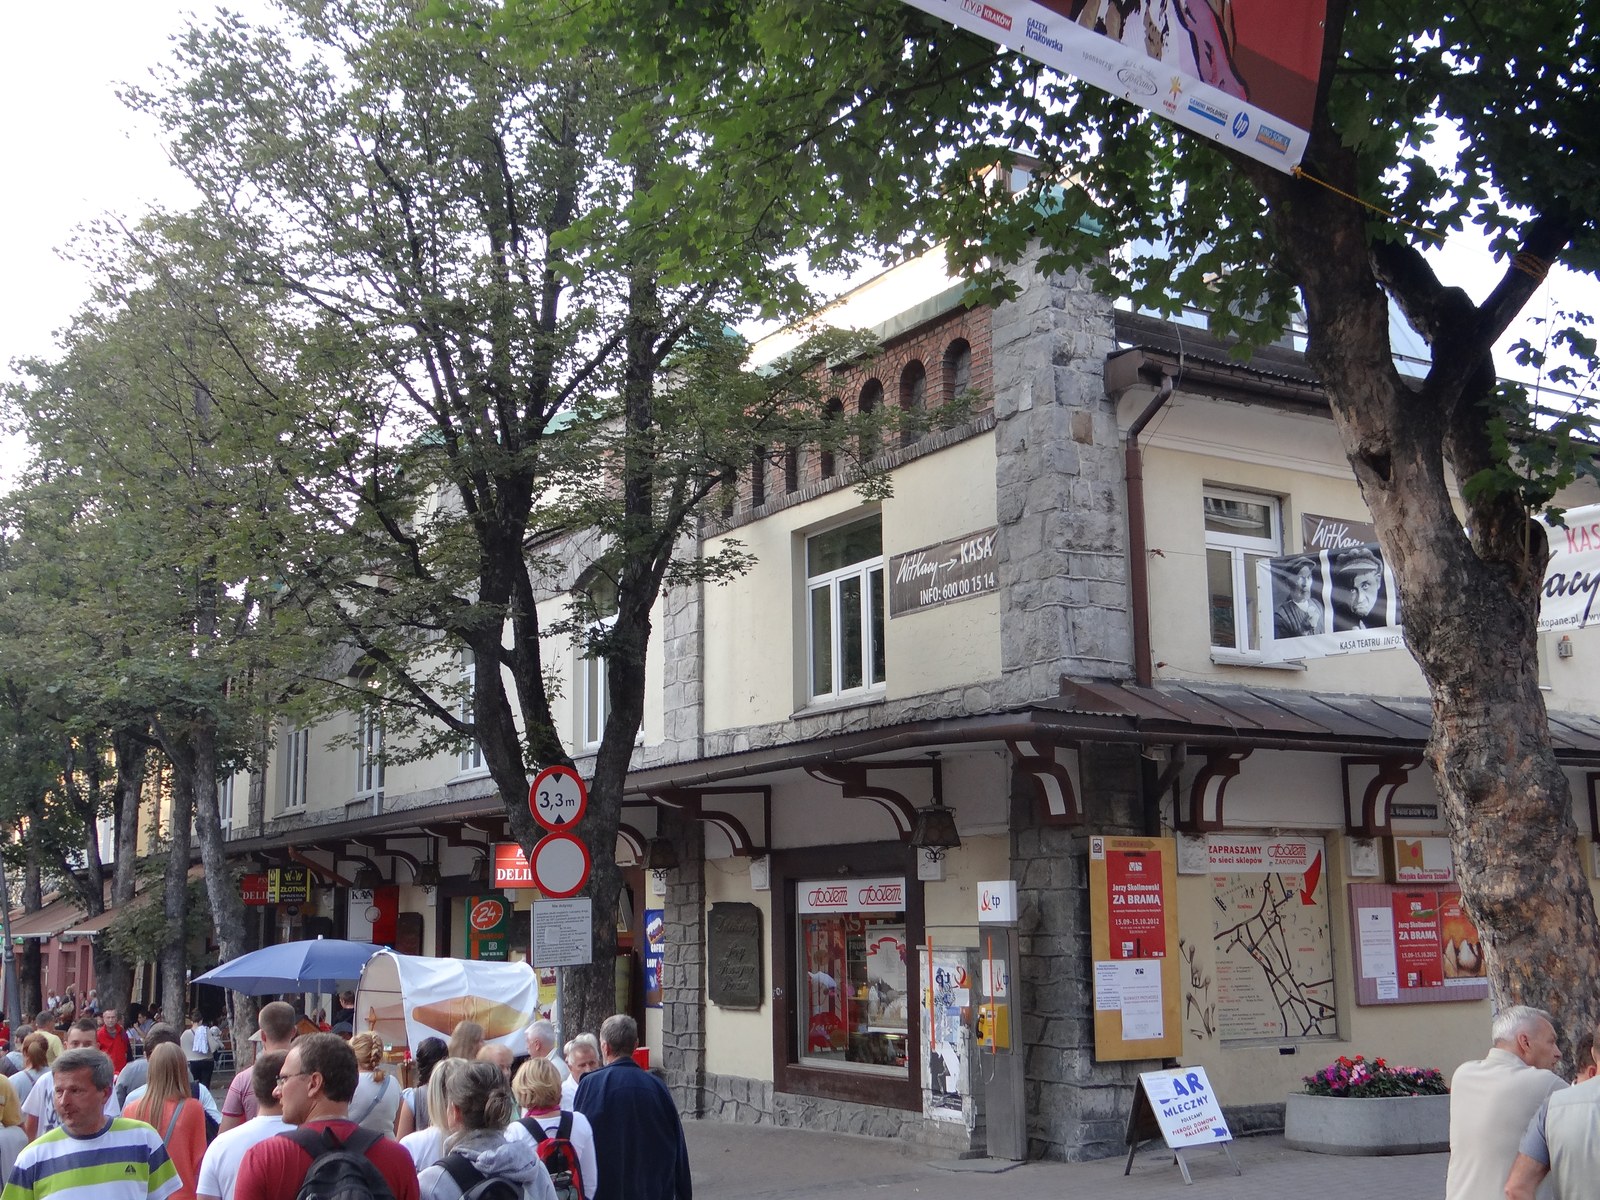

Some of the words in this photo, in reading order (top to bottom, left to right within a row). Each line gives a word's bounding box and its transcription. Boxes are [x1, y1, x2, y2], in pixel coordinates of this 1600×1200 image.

[962, 0, 982, 16] TVP
[983, 7, 1012, 28] KRAKÓW
[1027, 18, 1048, 34] GAZETA
[1026, 27, 1063, 52] Krakowska
[1234, 113, 1249, 134] hp
[960, 536, 993, 565] KASA
[920, 587, 942, 606] INFO:
[942, 582, 958, 600] 600
[959, 579, 970, 595] 00
[971, 576, 982, 592] 15
[984, 571, 995, 589] 14
[1339, 640, 1357, 650] KASA
[1357, 636, 1381, 649] TEATRU
[1208, 845, 1262, 855] ZAPRASZAMY
[1112, 884, 1126, 892] Jerzy
[992, 895, 1001, 909] tp
[1112, 895, 1125, 905] ZA
[1127, 895, 1161, 906] BRAMĄ
[477, 906, 496, 922] 24
[1398, 931, 1410, 940] ZA
[1410, 931, 1438, 940] BRAMĄ
[646, 959, 657, 968] LODY
[1163, 1094, 1209, 1118] MLECZNY
